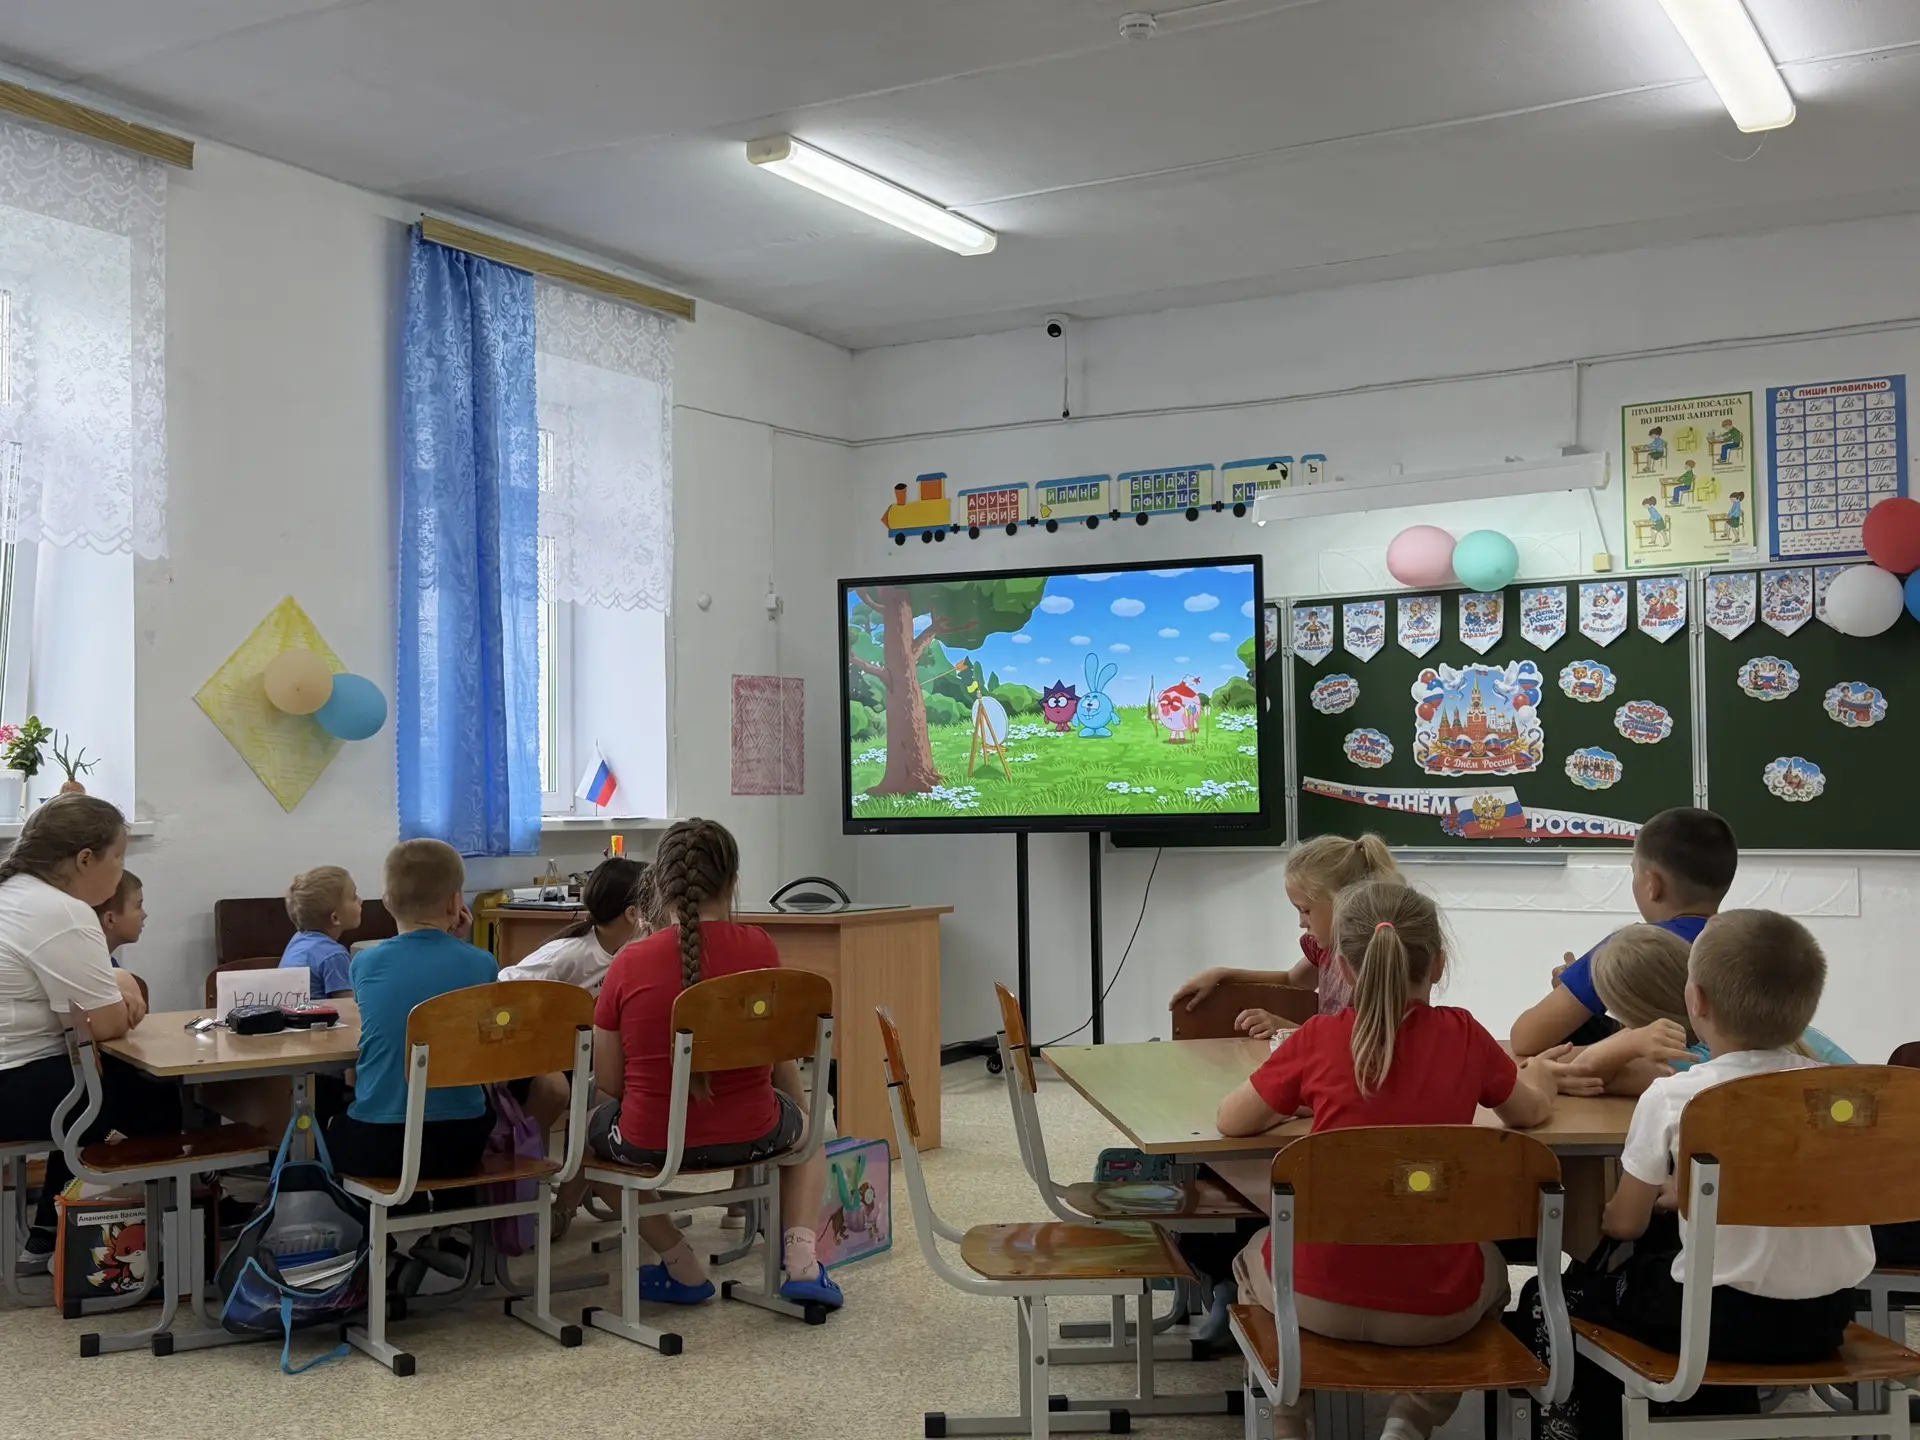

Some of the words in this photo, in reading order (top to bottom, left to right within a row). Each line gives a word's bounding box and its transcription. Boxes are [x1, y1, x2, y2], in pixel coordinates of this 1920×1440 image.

[1798, 387, 1828, 396] ПИШИ
[1830, 381, 1887, 394] ПРАВИЛЬНО
[1632, 403, 1694, 416] ПРАВИЛЬНАЯ
[1696, 398, 1742, 408] ПОСАДКА
[1654, 414, 1685, 423] ВРЕМЯ
[1687, 408, 1733, 420] ЗАНЯТИЙ
[1536, 596, 1549, 606] 12
[1444, 757, 1450, 766] С
[1454, 760, 1478, 769] Днём
[1482, 754, 1516, 769] России!
[1364, 792, 1379, 806] С
[1387, 789, 1451, 815] ДНЁМ
[234, 990, 310, 1008] ЮНОСТЬ
[79, 1214, 119, 1222] Ананичева
